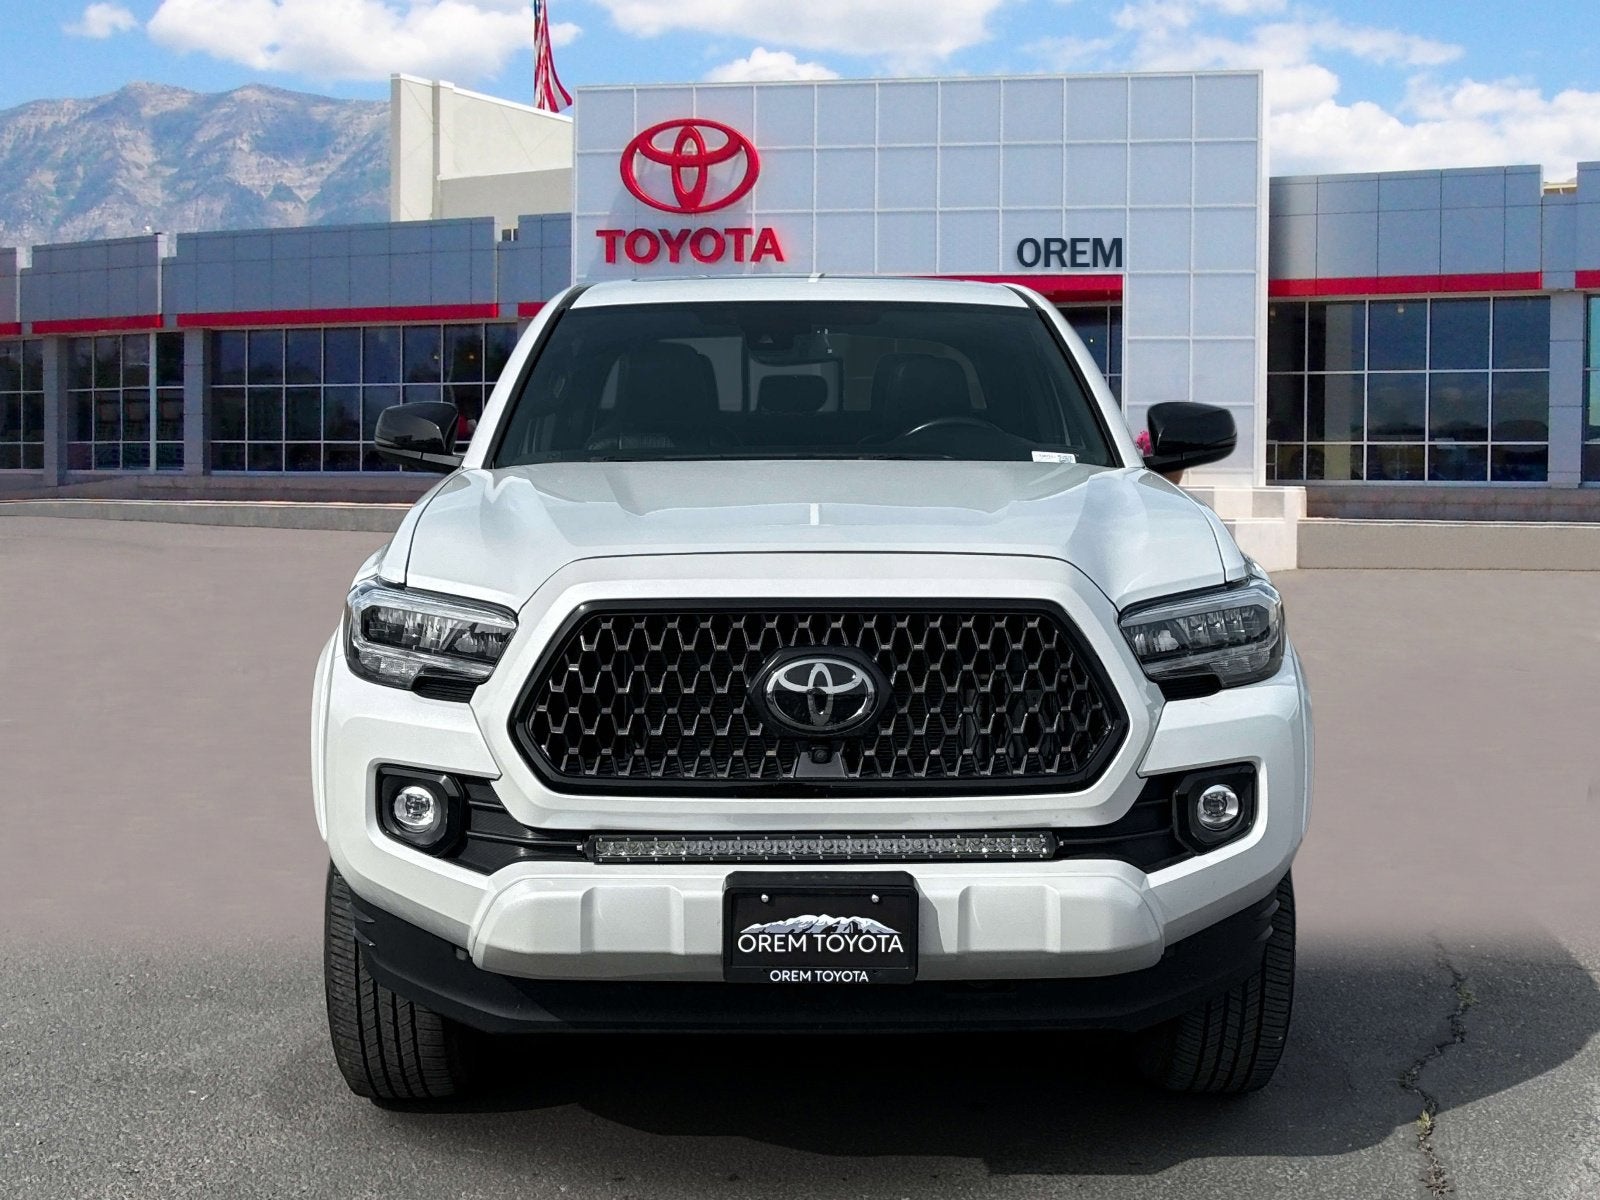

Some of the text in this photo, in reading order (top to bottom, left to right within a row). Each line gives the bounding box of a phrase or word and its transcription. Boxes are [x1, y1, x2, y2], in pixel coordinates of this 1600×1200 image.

[596, 227, 785, 264] TOYOTA
[1017, 237, 1123, 268] OREM
[738, 934, 904, 953] OREM TOYOTA
[769, 970, 869, 983] OREM TOYOTA
